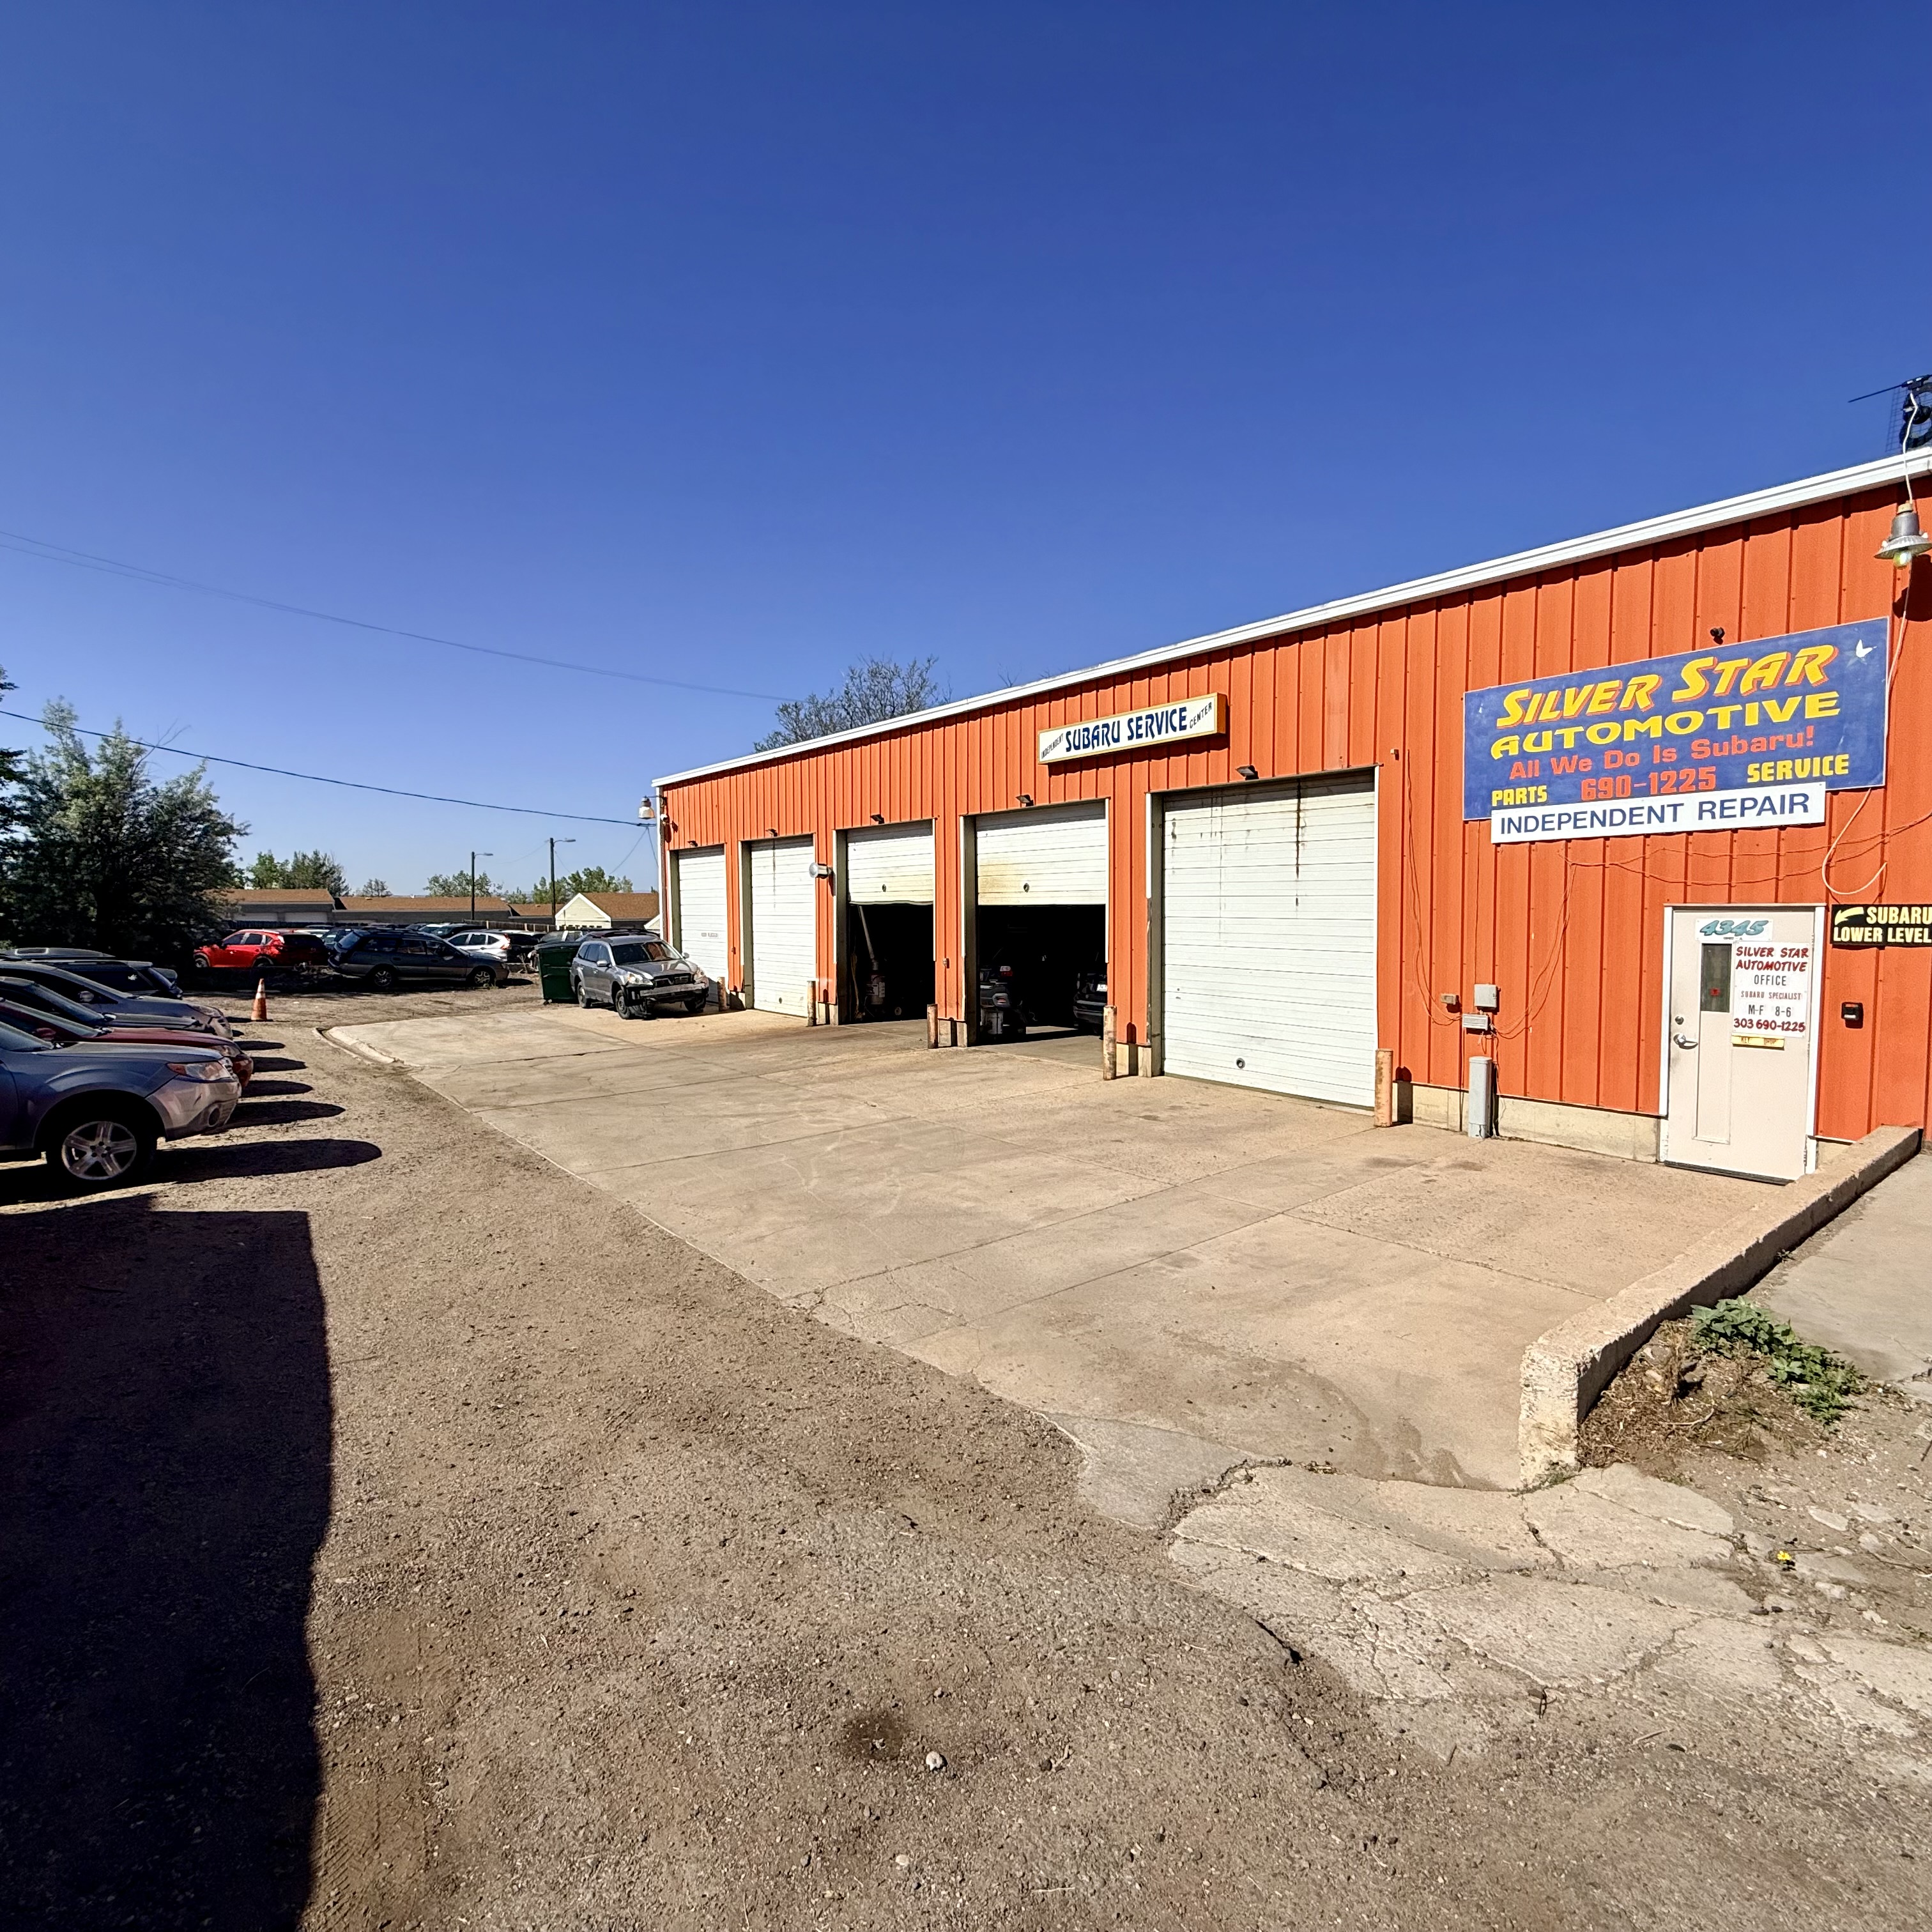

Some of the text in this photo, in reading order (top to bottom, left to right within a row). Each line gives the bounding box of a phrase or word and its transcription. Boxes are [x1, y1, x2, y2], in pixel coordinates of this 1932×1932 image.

[1496, 645, 1839, 729] SILVER STAR
[1066, 720, 1121, 752] SUBARU
[1127, 706, 1187, 740] SERVICE
[1189, 702, 1212, 729] CENTER
[1491, 691, 1840, 760] AUTOMOTIVE
[1510, 725, 1814, 779] All We Do Is Subaru!
[1747, 754, 1850, 783] SERVICE
[1581, 766, 1717, 801] 690-1225
[1492, 785, 1547, 807] PARTS
[1500, 793, 1809, 835] INDEPENDENT REPAIR
[1866, 907, 1932, 924] SUBARU
[1699, 920, 1769, 937] 4345
[1833, 926, 1932, 943] LOWER LEVEL
[1736, 946, 1809, 958] SILVER STAR
[1735, 960, 1807, 972] AUTOMOTIVE
[1754, 974, 1786, 986] OFFICE
[1748, 1004, 1791, 1017] M-F 8-6
[1733, 1018, 1805, 1032] 303 690-1225
